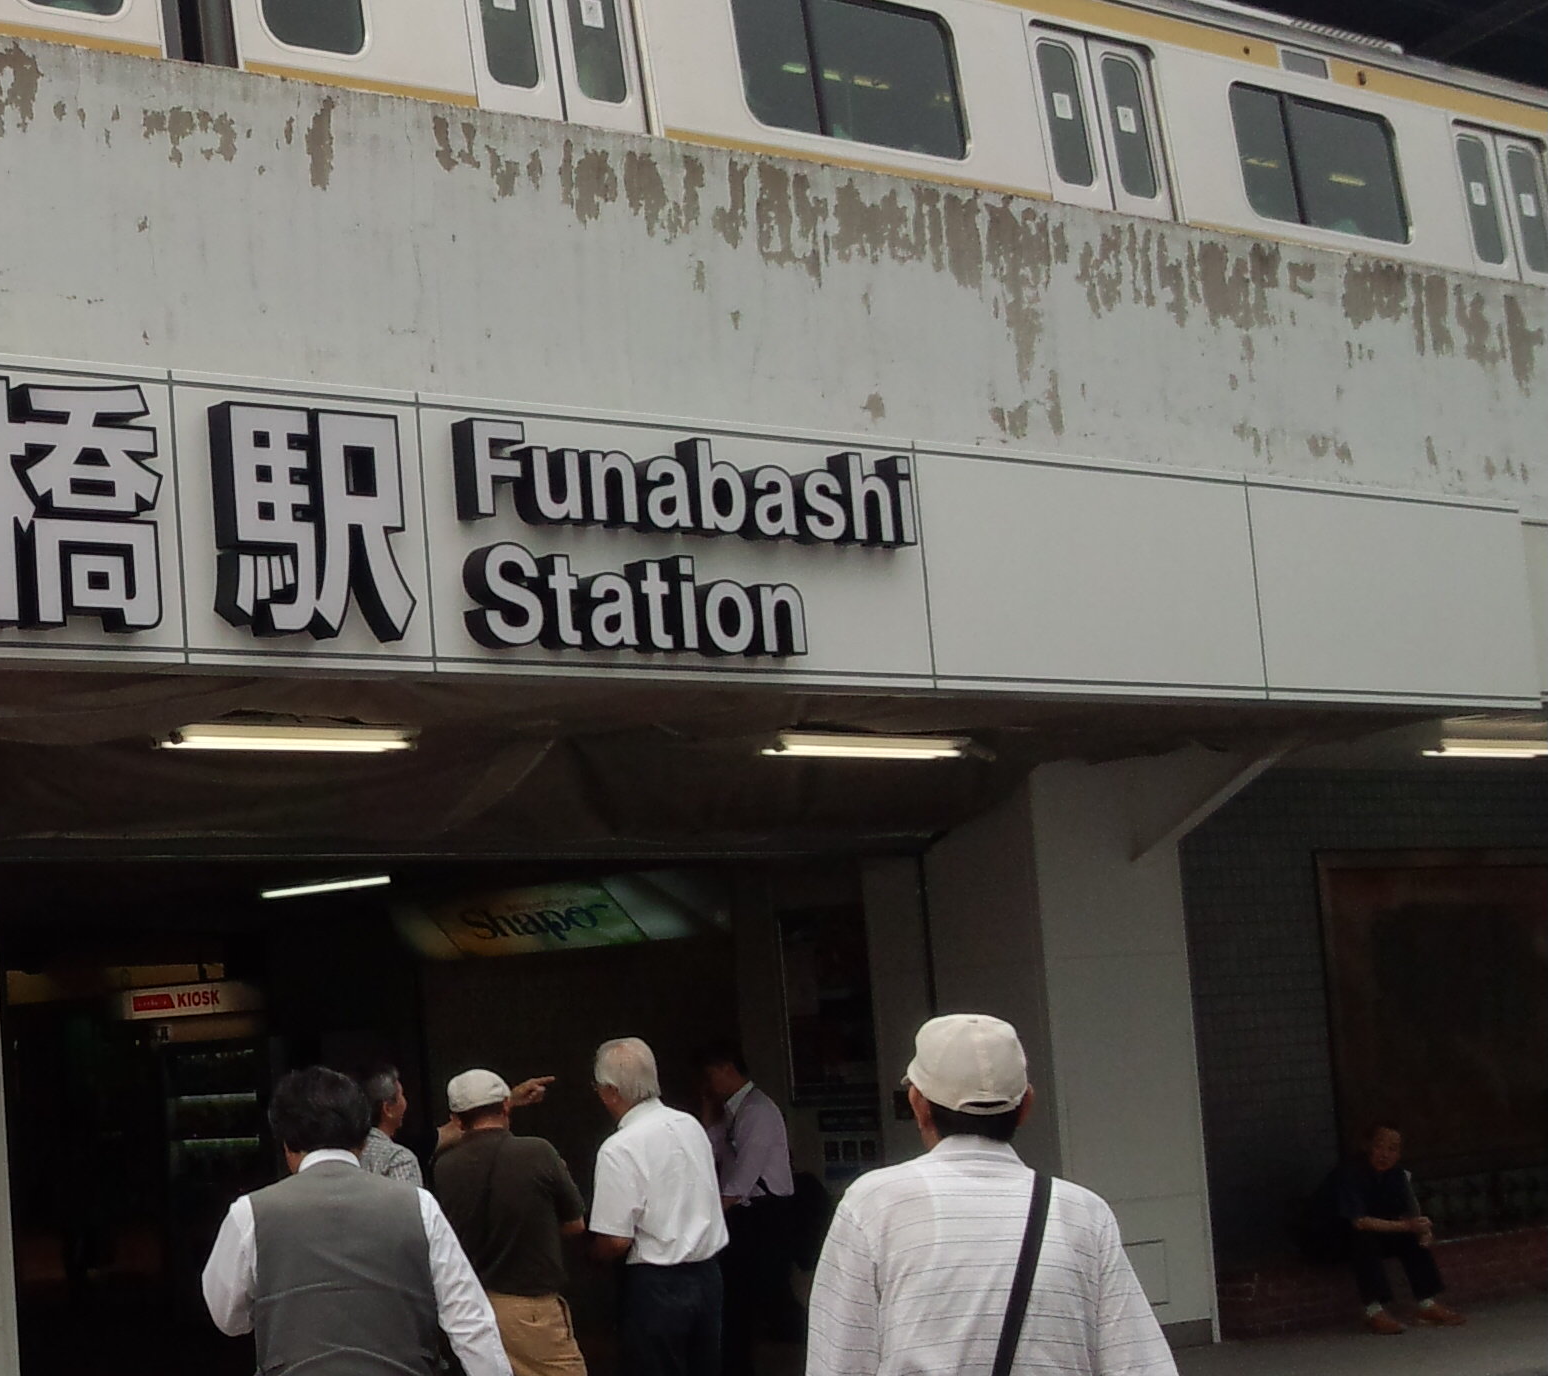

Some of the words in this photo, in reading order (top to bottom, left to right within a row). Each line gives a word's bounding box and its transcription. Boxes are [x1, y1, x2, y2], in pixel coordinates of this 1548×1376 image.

[452, 417, 918, 550] Funabashi
[463, 541, 809, 658] Station
[459, 903, 608, 942] Shapo
[176, 990, 220, 1008] KIOSK
